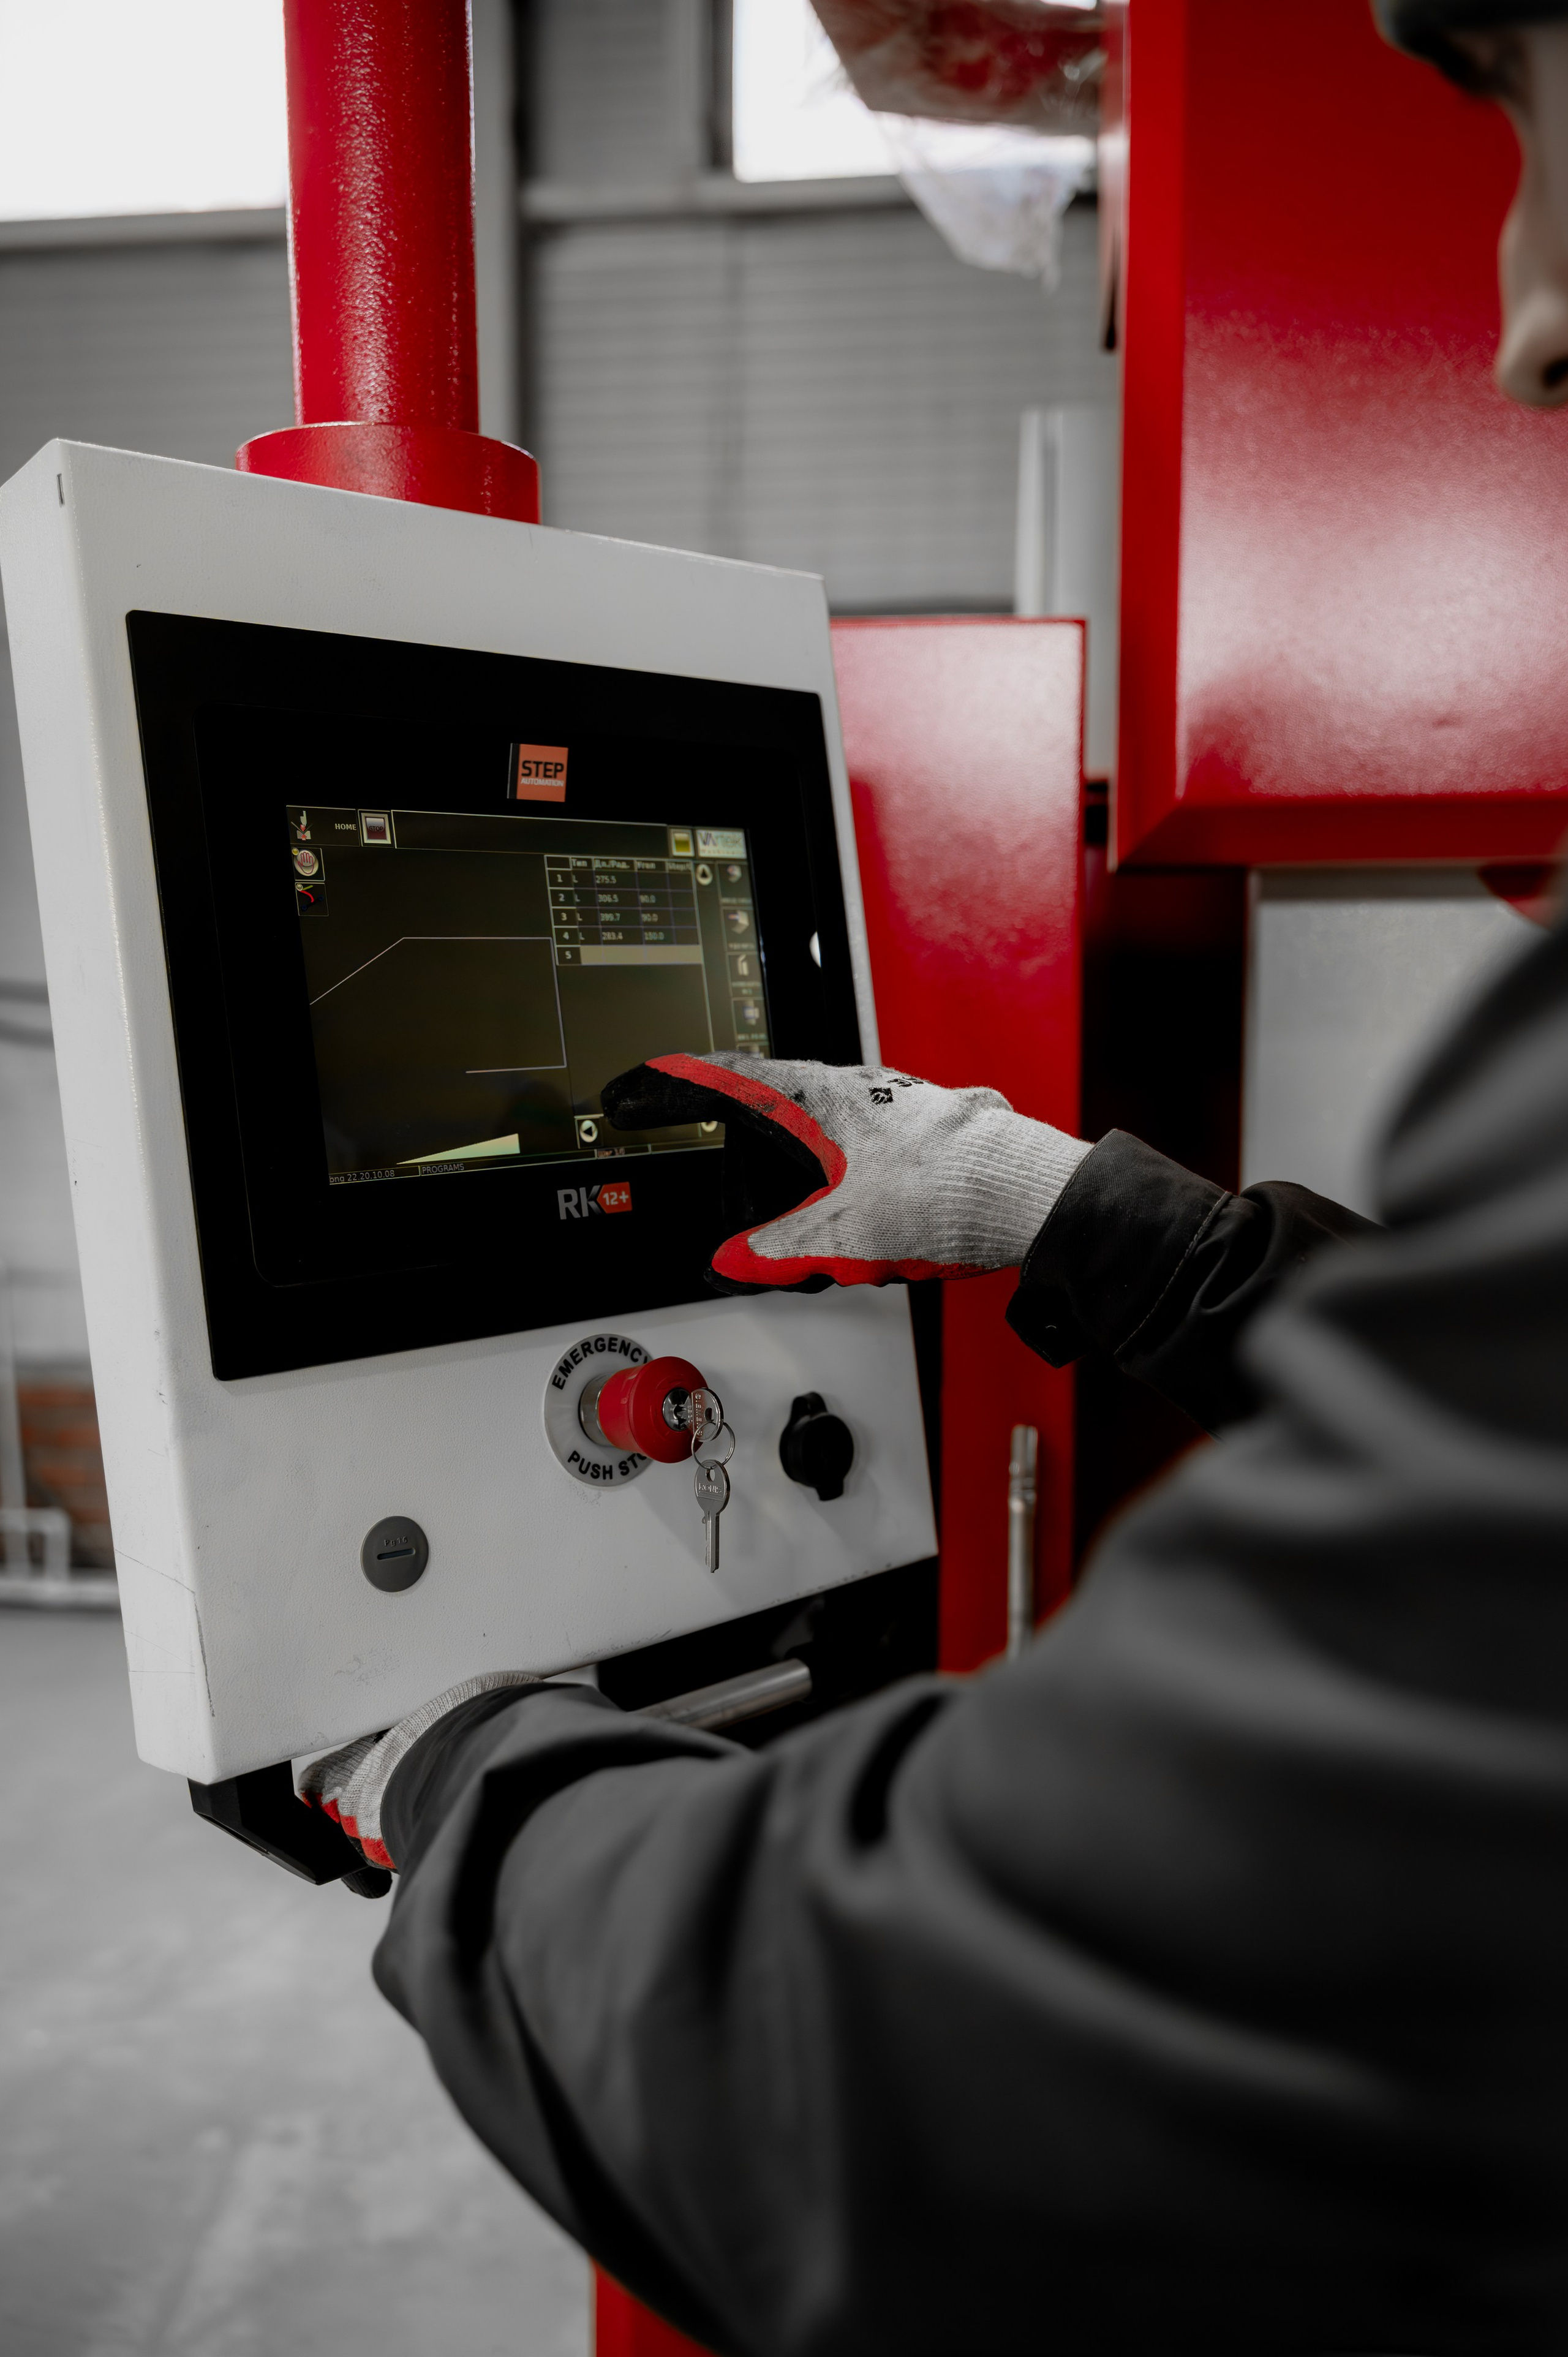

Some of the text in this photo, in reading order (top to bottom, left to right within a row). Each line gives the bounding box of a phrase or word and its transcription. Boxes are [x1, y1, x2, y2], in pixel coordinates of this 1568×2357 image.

[521, 760, 564, 779] STEP
[521, 777, 564, 787] AUTOMATION
[556, 874, 564, 883] 1
[595, 875, 617, 884] 275.5
[558, 893, 565, 902] 2
[562, 931, 570, 940] 4
[565, 951, 571, 959] 5
[422, 1163, 464, 1174] PROGRAMS
[347, 1170, 395, 1182] 22.20.10.08
[557, 1185, 629, 1220] RK 12+
[567, 1450, 613, 1480] PUSH
